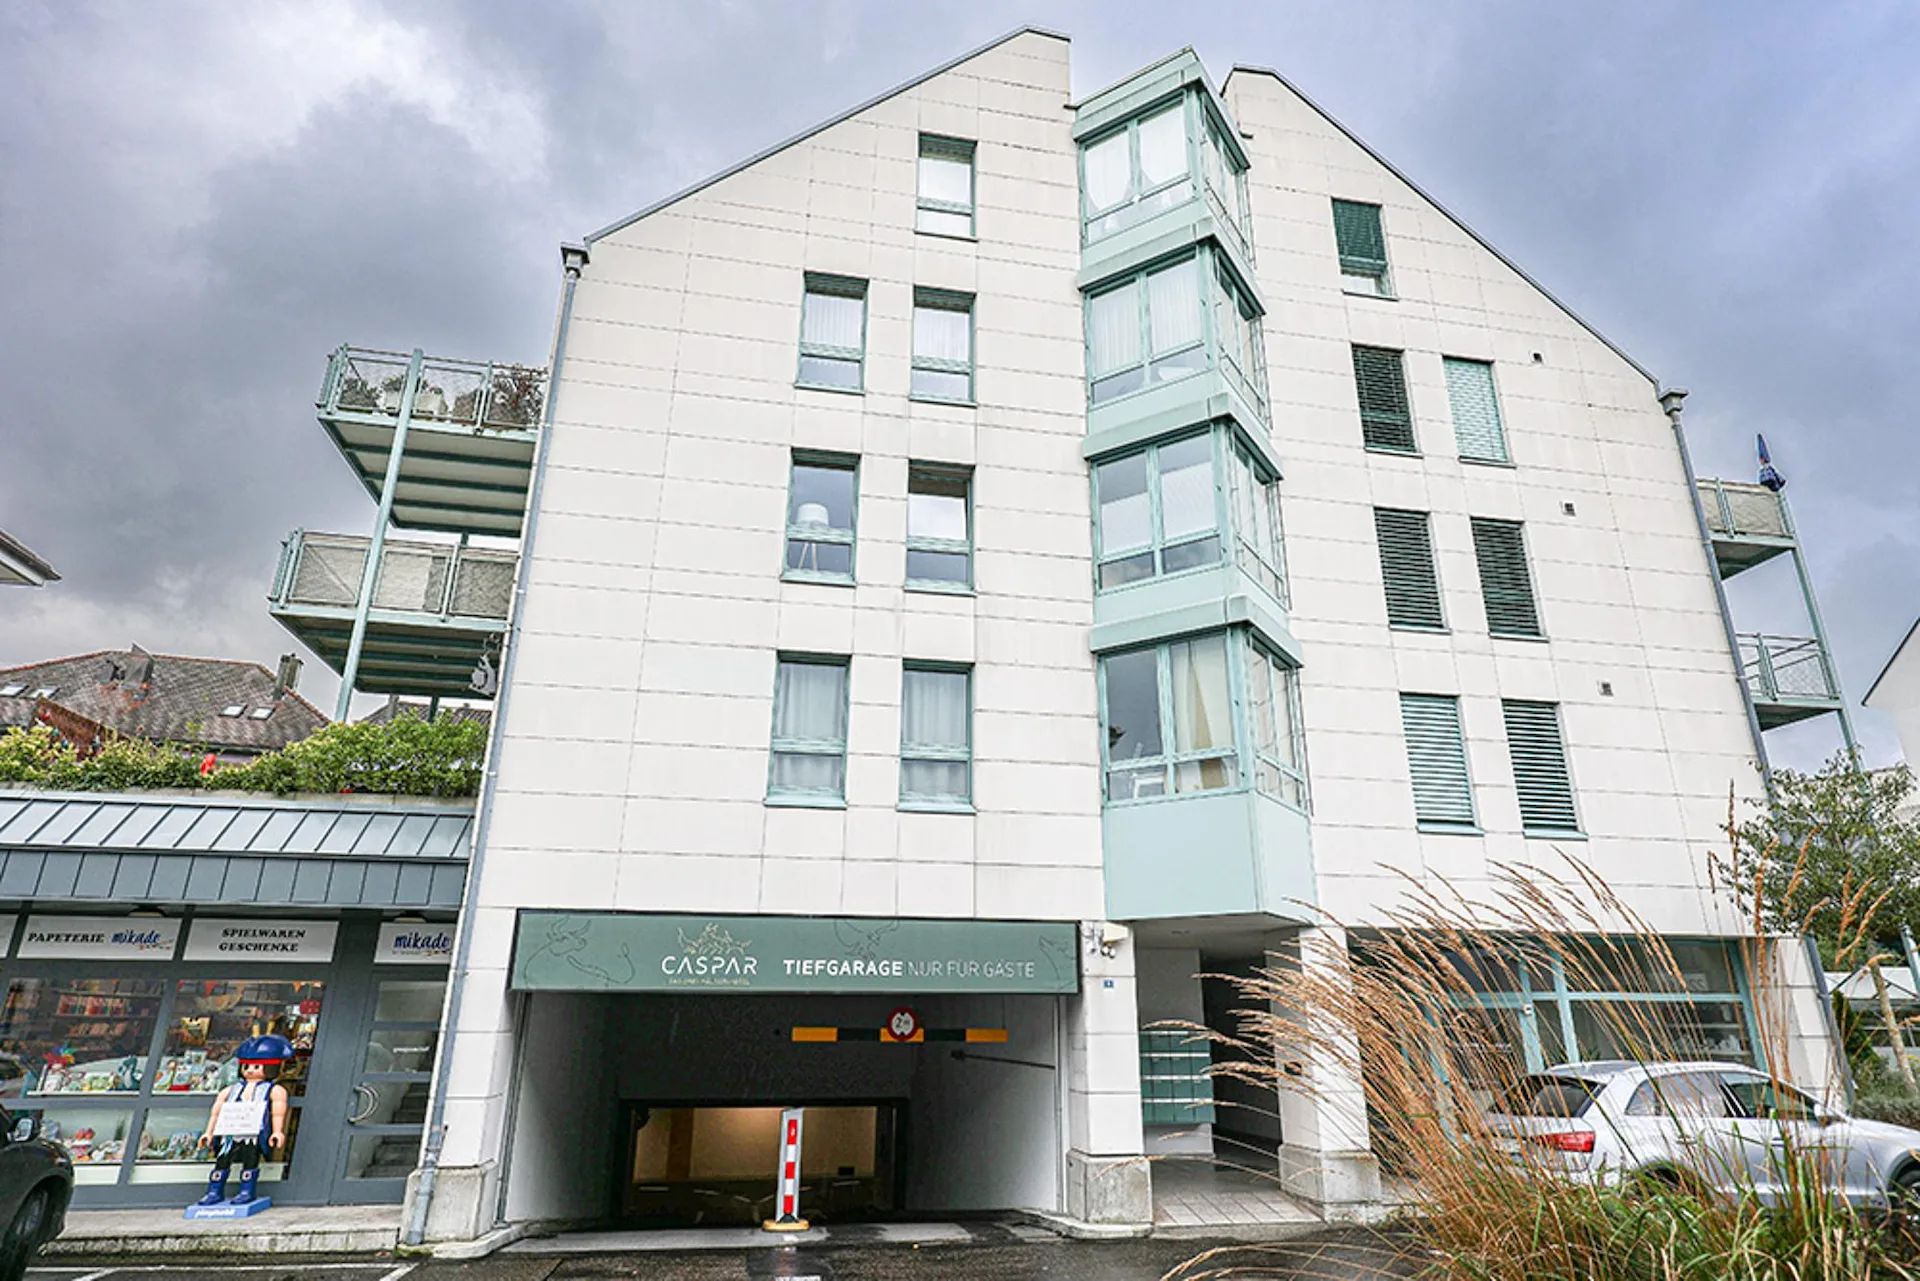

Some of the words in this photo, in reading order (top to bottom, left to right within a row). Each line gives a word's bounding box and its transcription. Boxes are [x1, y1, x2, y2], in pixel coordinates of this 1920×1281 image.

[27, 932, 105, 943] PAPETERIE
[222, 928, 306, 938] SPIELWAREN
[218, 942, 299, 952] GESCHENKE
[661, 956, 758, 975] CASPAR
[783, 959, 903, 976] TIEFGARAGE
[906, 961, 944, 977] NUR
[947, 959, 980, 978] FÜR
[983, 960, 1035, 978] GÄSTE
